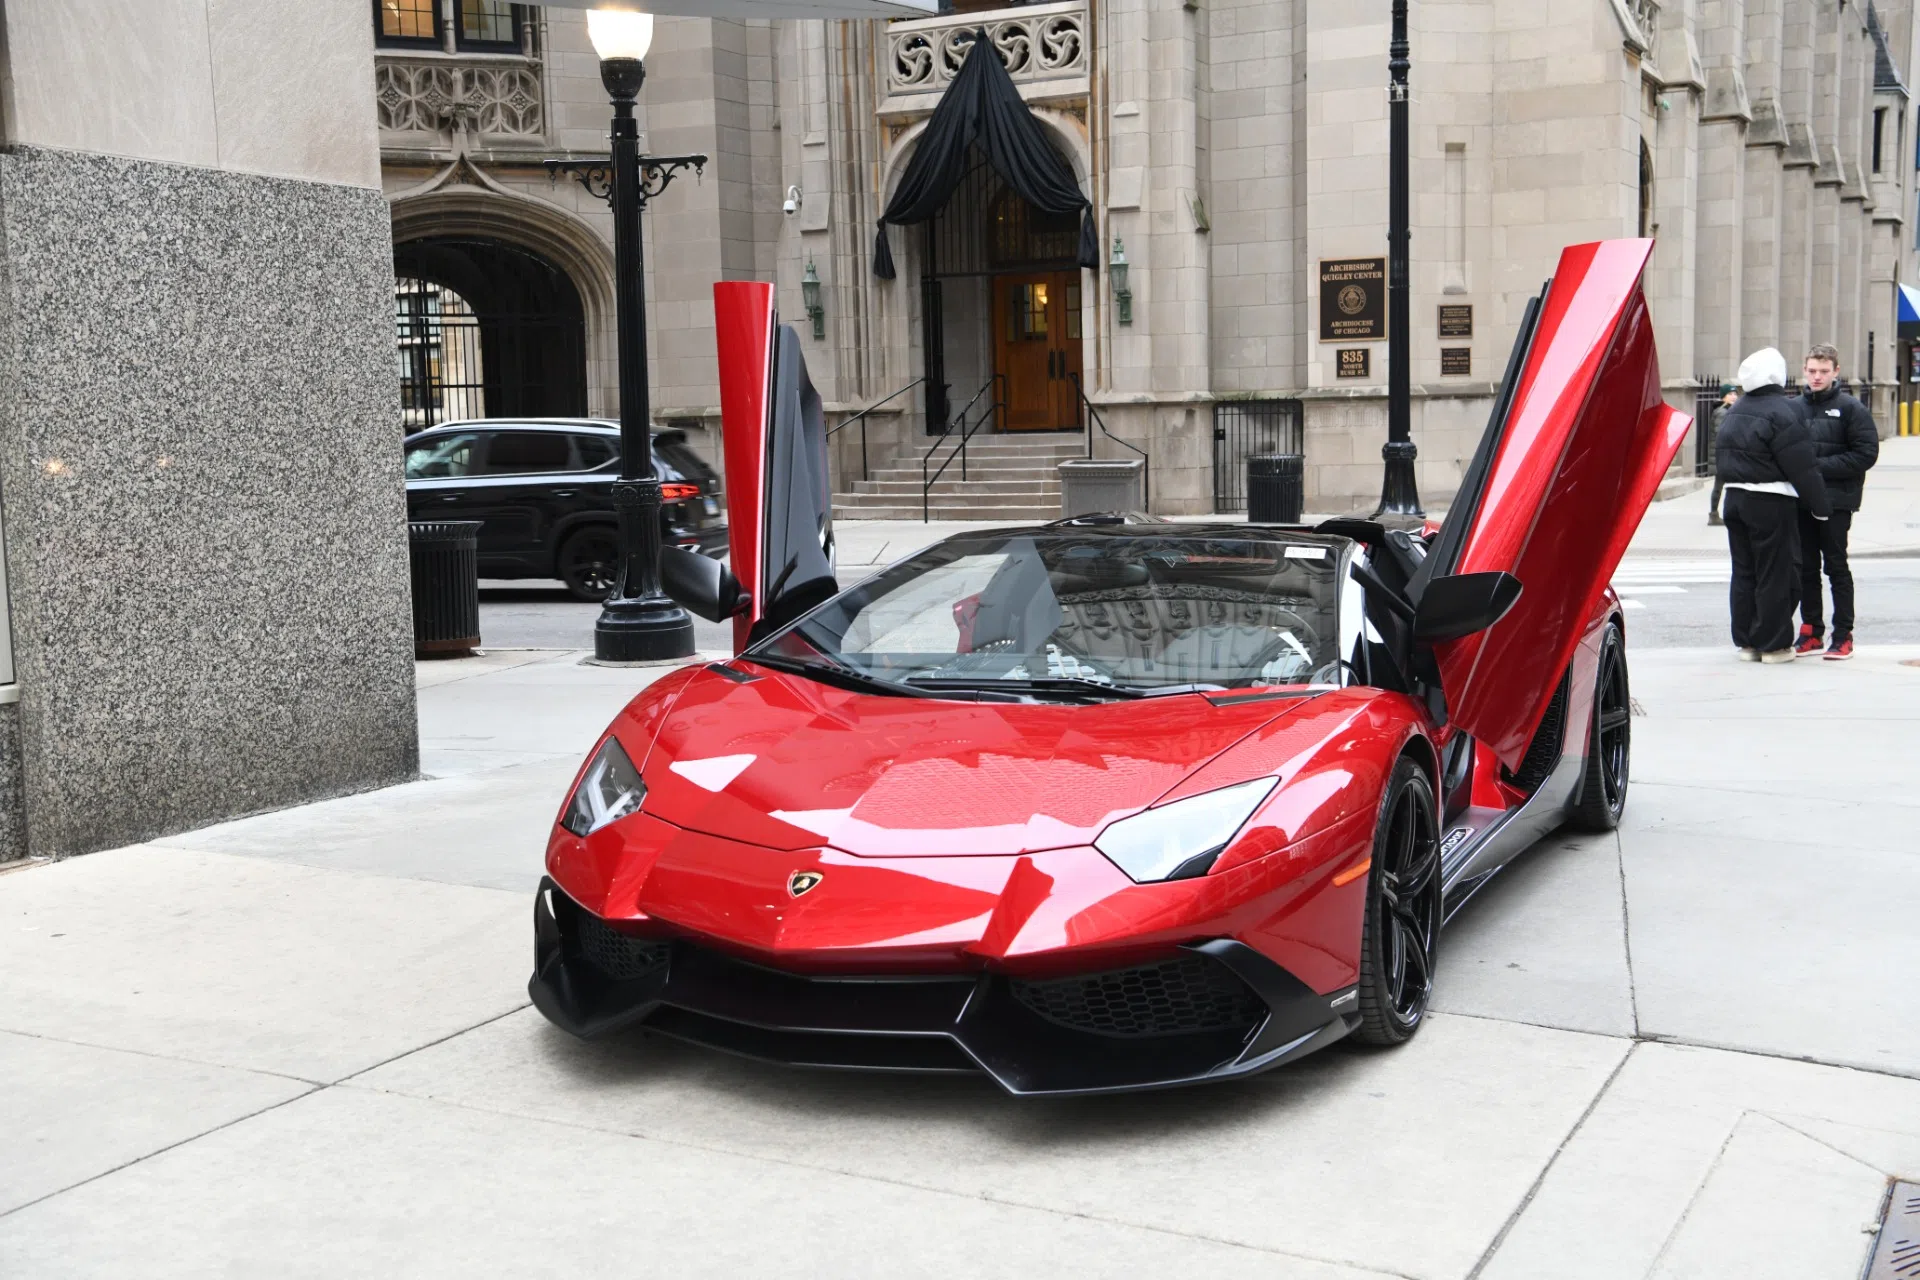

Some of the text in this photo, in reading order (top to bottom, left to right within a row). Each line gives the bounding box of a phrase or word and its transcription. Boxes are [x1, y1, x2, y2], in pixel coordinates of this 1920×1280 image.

[1329, 263, 1375, 271] ARCHBISHOP
[1322, 271, 1383, 282] QUIGLEY CENTER
[1331, 320, 1374, 328] ARCHDIOCESE
[1343, 327, 1371, 335] CHICAGO
[1342, 351, 1364, 363] 835
[1441, 831, 1466, 857] NTADOR
